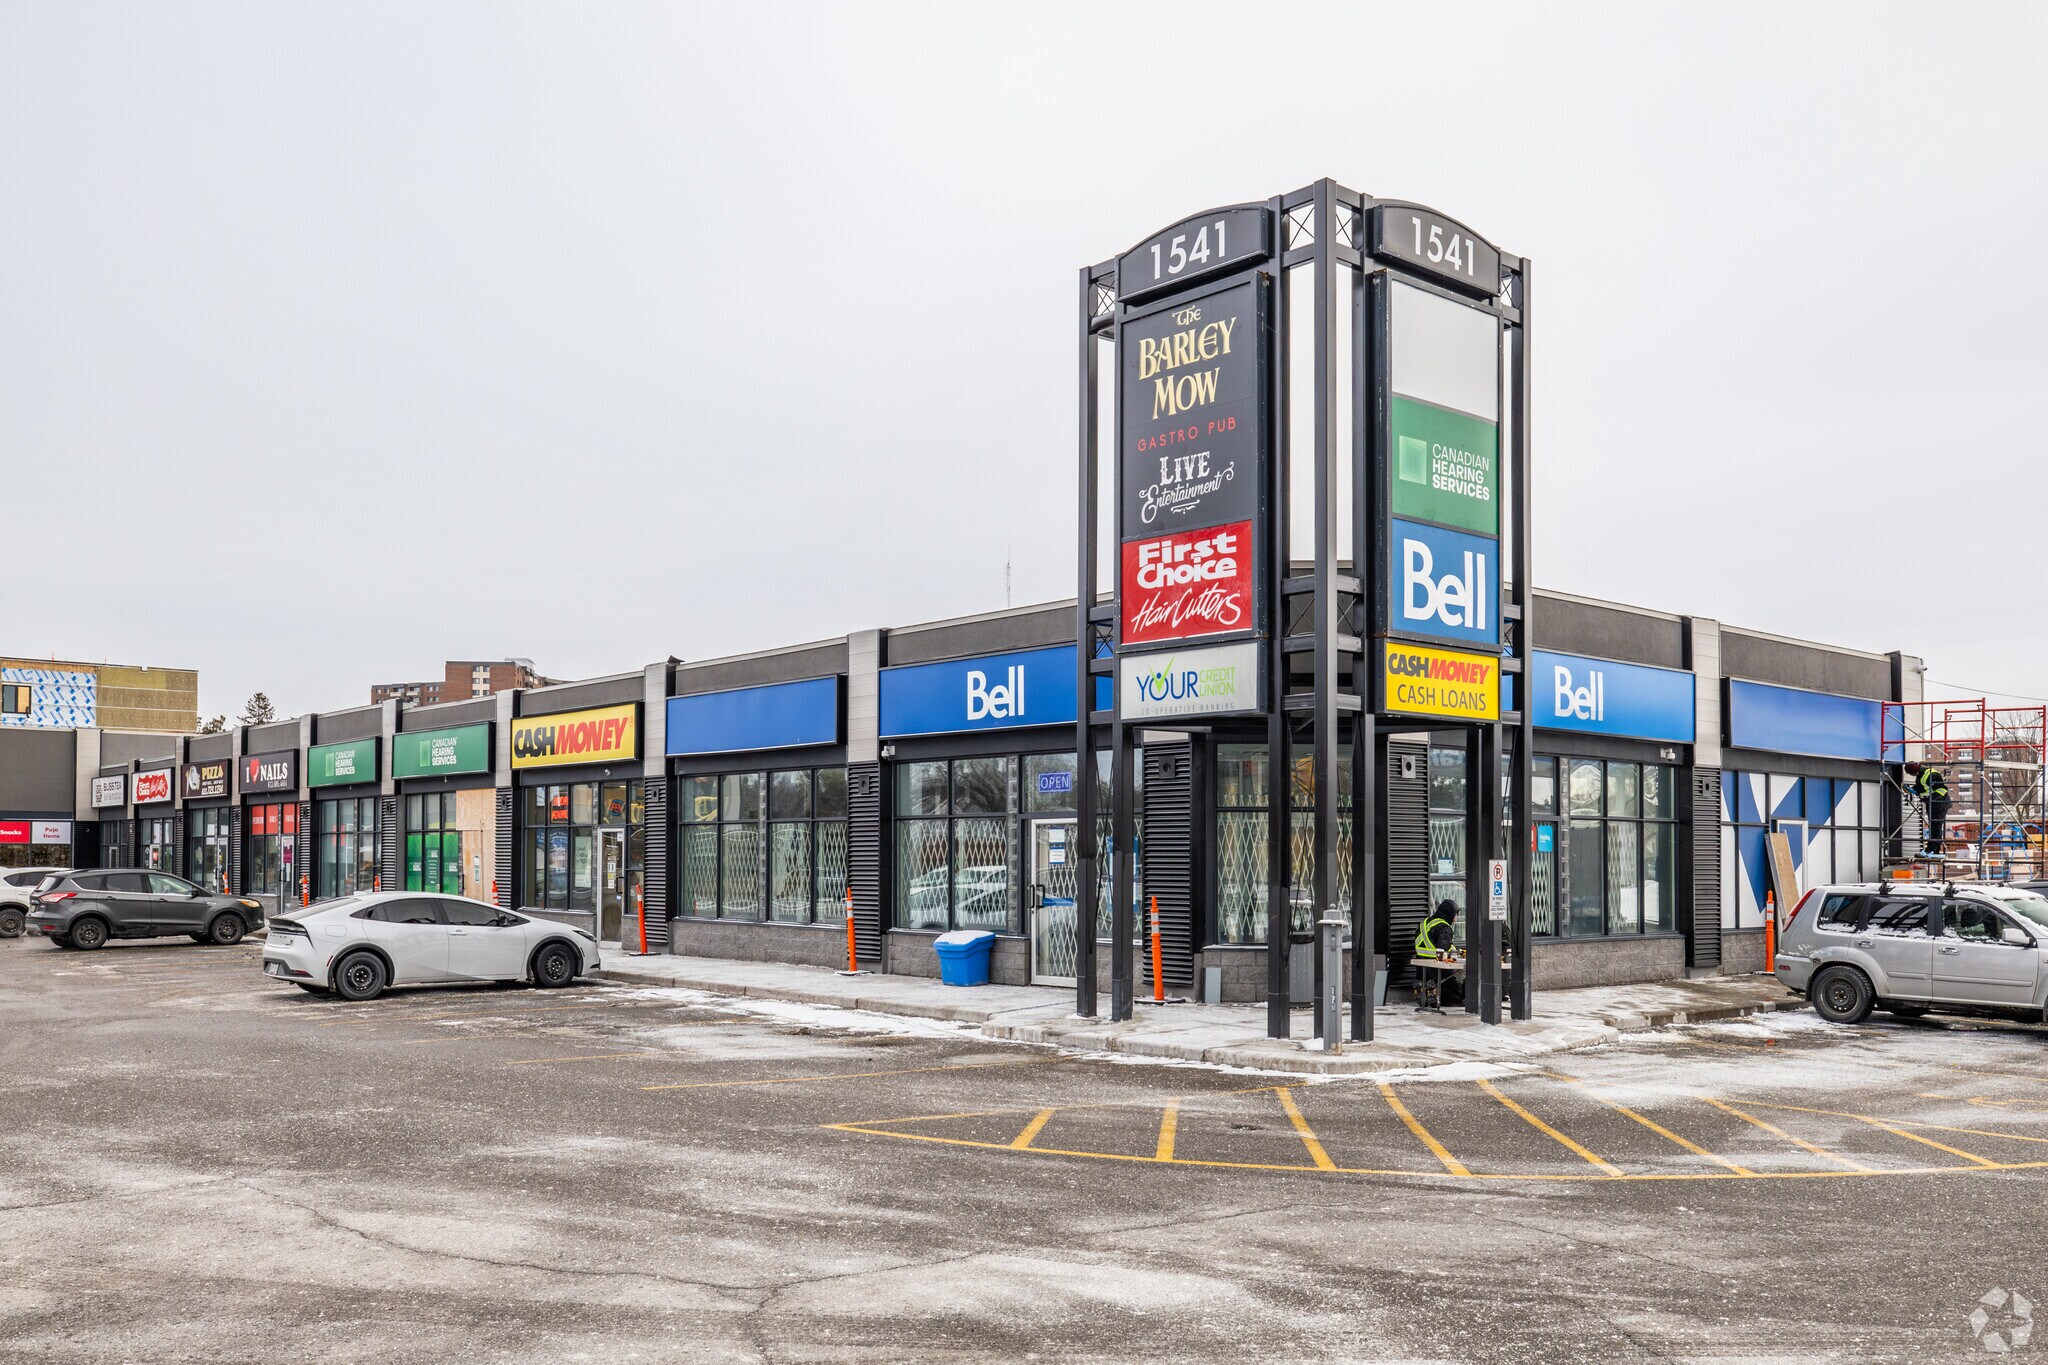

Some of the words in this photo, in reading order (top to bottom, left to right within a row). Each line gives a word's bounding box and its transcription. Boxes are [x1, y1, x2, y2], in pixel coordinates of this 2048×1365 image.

[1150, 219, 1226, 280] 1541
[1412, 216, 1474, 277] 1541
[1172, 305, 1202, 327] The
[1138, 316, 1237, 381] BARLEY
[1151, 367, 1220, 420] MOW
[1137, 426, 1199, 452] GASTRO
[1208, 416, 1237, 436] PUB
[1159, 451, 1211, 487] LIVE
[1432, 443, 1490, 472] CANADIAN
[1432, 458, 1485, 486] HEARING
[1139, 461, 1235, 524] Entertainment
[1432, 472, 1490, 501] SERVICES
[1138, 532, 1237, 568] First
[1137, 554, 1237, 590] Choice
[1403, 537, 1486, 631] Bell
[1136, 665, 1199, 703] YOUR
[1199, 666, 1236, 684] CREDIT
[1199, 681, 1236, 698] UNION
[966, 664, 1025, 721] Bell
[1397, 683, 1436, 706] CASH
[1441, 689, 1487, 712] LOANS
[1554, 665, 1604, 721] Bell
[1199, 702, 1235, 713] BANKING
[335, 750, 355, 759] CANADIAN
[432, 738, 457, 748] CANADIAN
[432, 747, 455, 757] HEARING
[201, 765, 224, 780] PIZZA
[246, 766, 250, 783] I
[260, 762, 288, 781] NAILS
[335, 758, 353, 767] HEARING
[335, 766, 355, 776] SERVICES
[432, 755, 457, 766] SERVICES
[1040, 775, 1070, 790] OPEN
